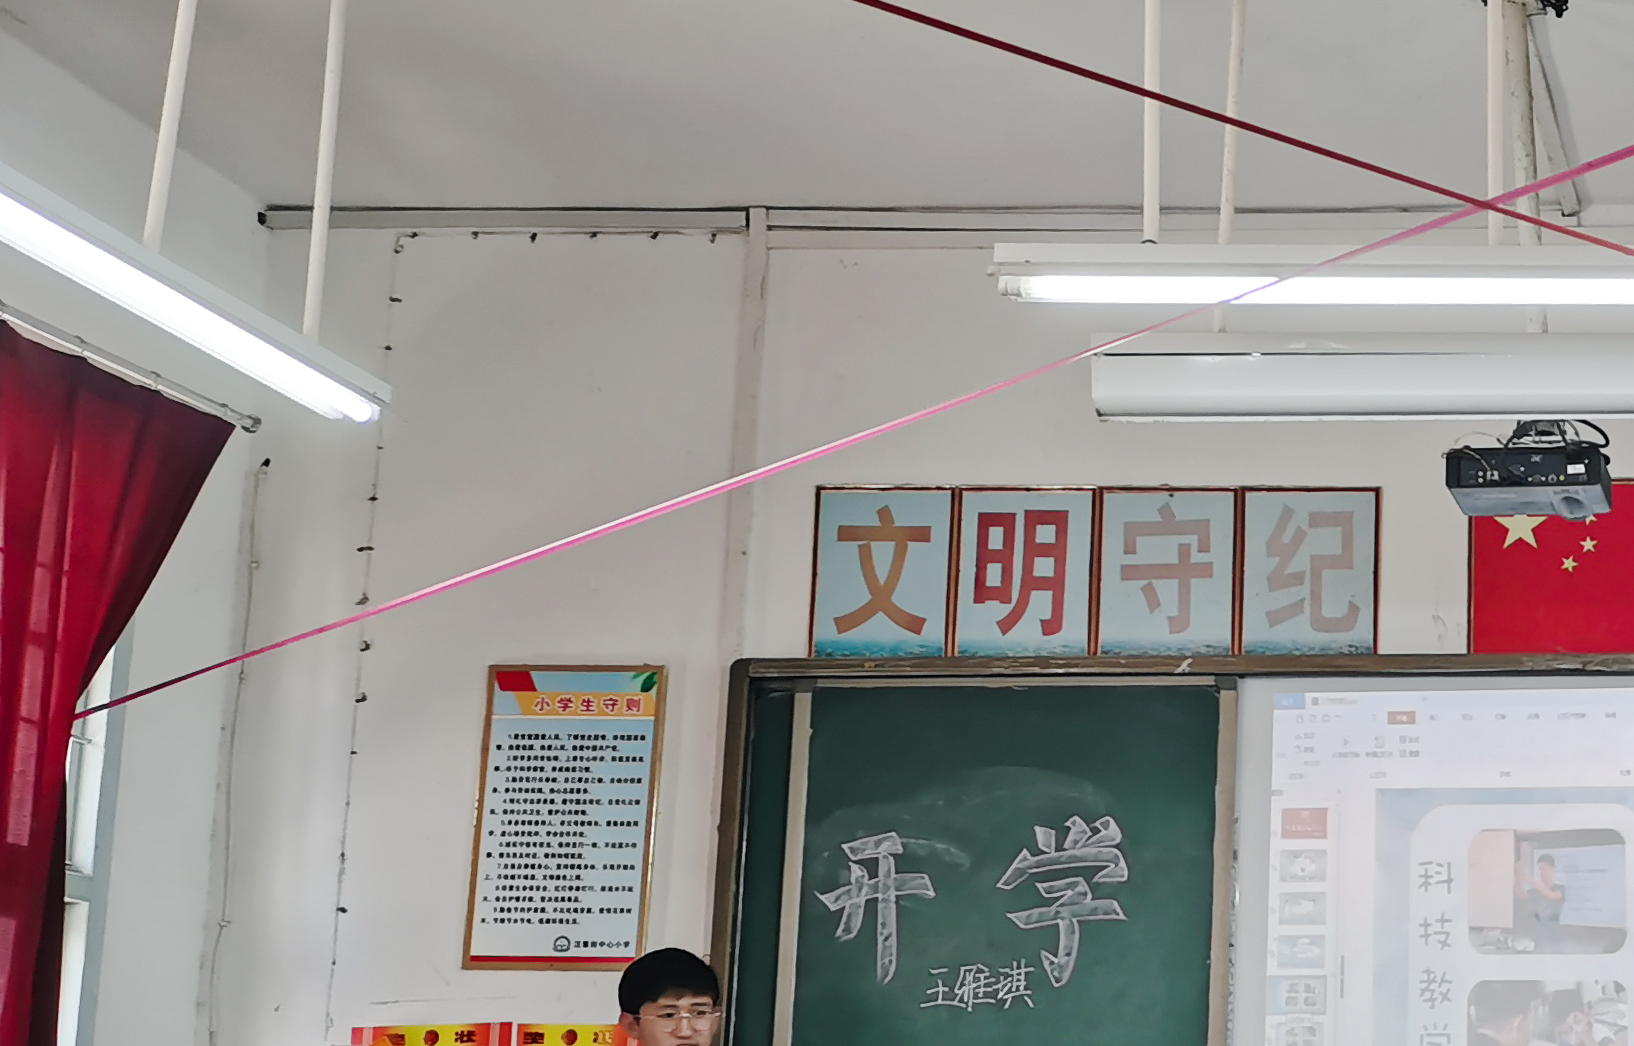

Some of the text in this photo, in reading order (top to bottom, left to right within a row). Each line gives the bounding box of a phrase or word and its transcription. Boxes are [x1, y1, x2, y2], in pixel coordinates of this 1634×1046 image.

[833, 504, 1362, 637] 文明守纪
[533, 694, 645, 714] 小学生守则
[813, 814, 1129, 988] 开学
